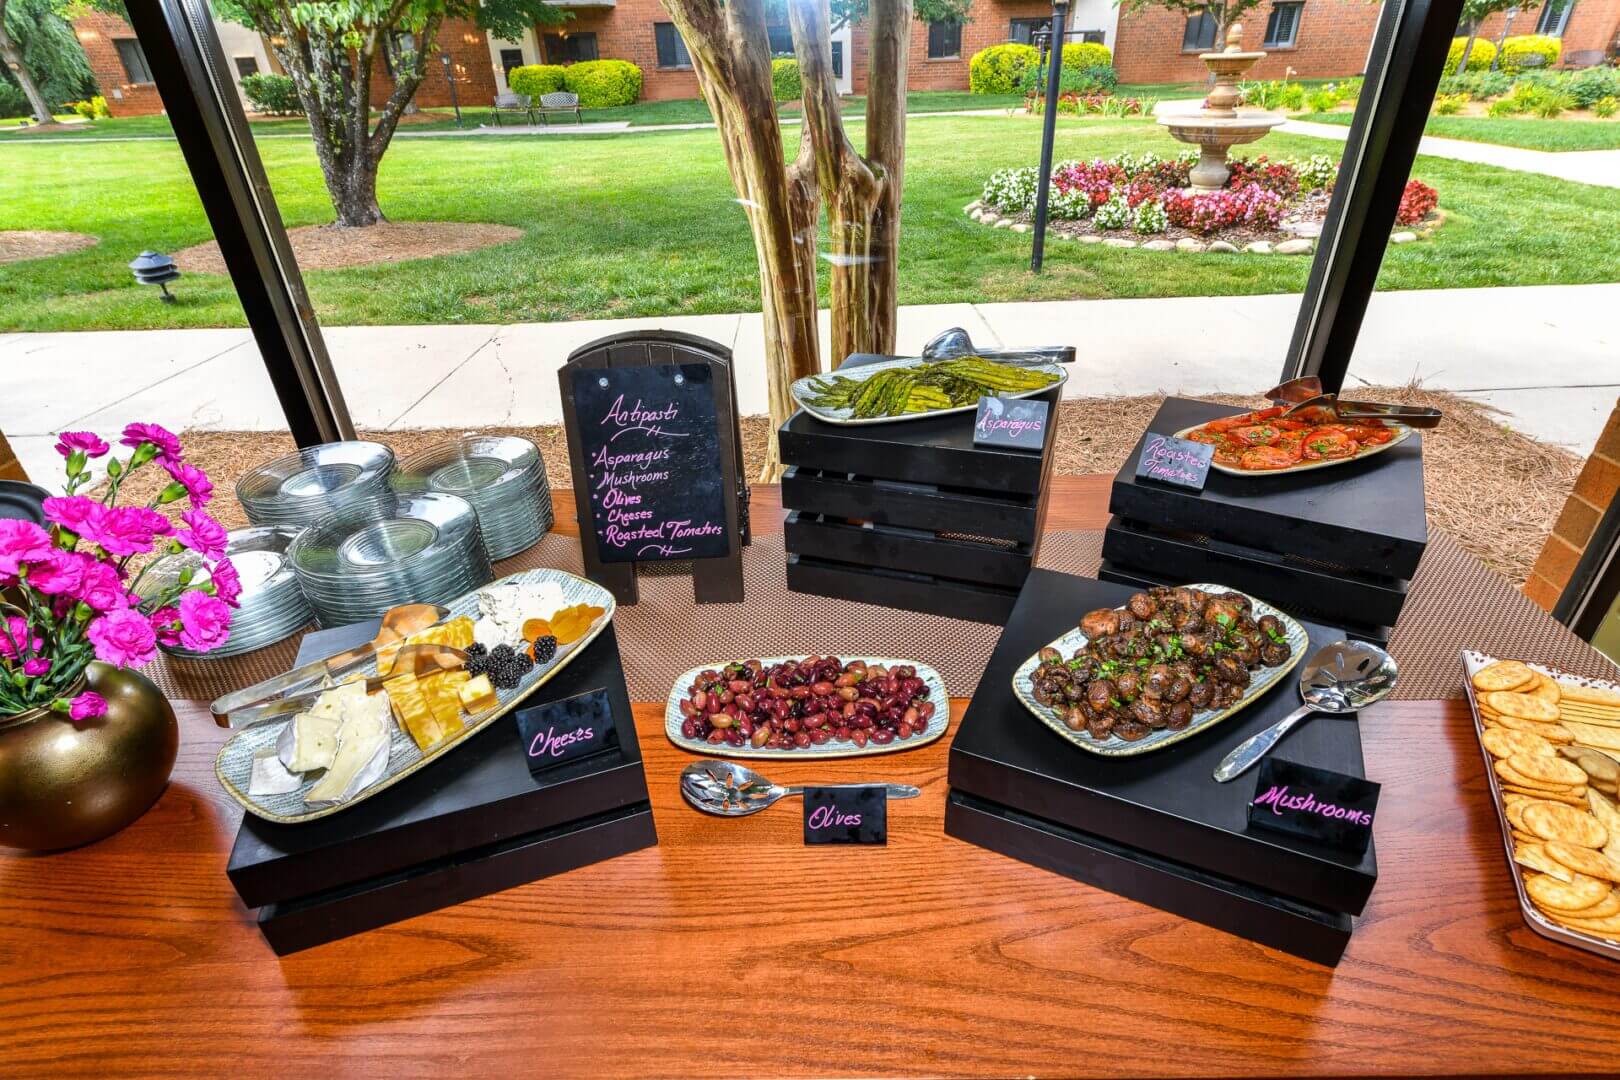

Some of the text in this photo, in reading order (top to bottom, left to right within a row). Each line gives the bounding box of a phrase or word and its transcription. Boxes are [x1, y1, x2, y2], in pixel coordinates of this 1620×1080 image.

[601, 393, 679, 426] Antipasti
[977, 408, 1041, 437] Asparagus
[594, 445, 669, 470] Asparagus
[597, 469, 669, 489] Mushrooms
[603, 490, 641, 508] Olives
[608, 507, 653, 525] Cheeses
[606, 520, 722, 547] Roasted Tomatoes
[529, 726, 594, 757] Cheeses
[808, 804, 862, 829] Olives
[1254, 785, 1371, 825] Mushrooms
